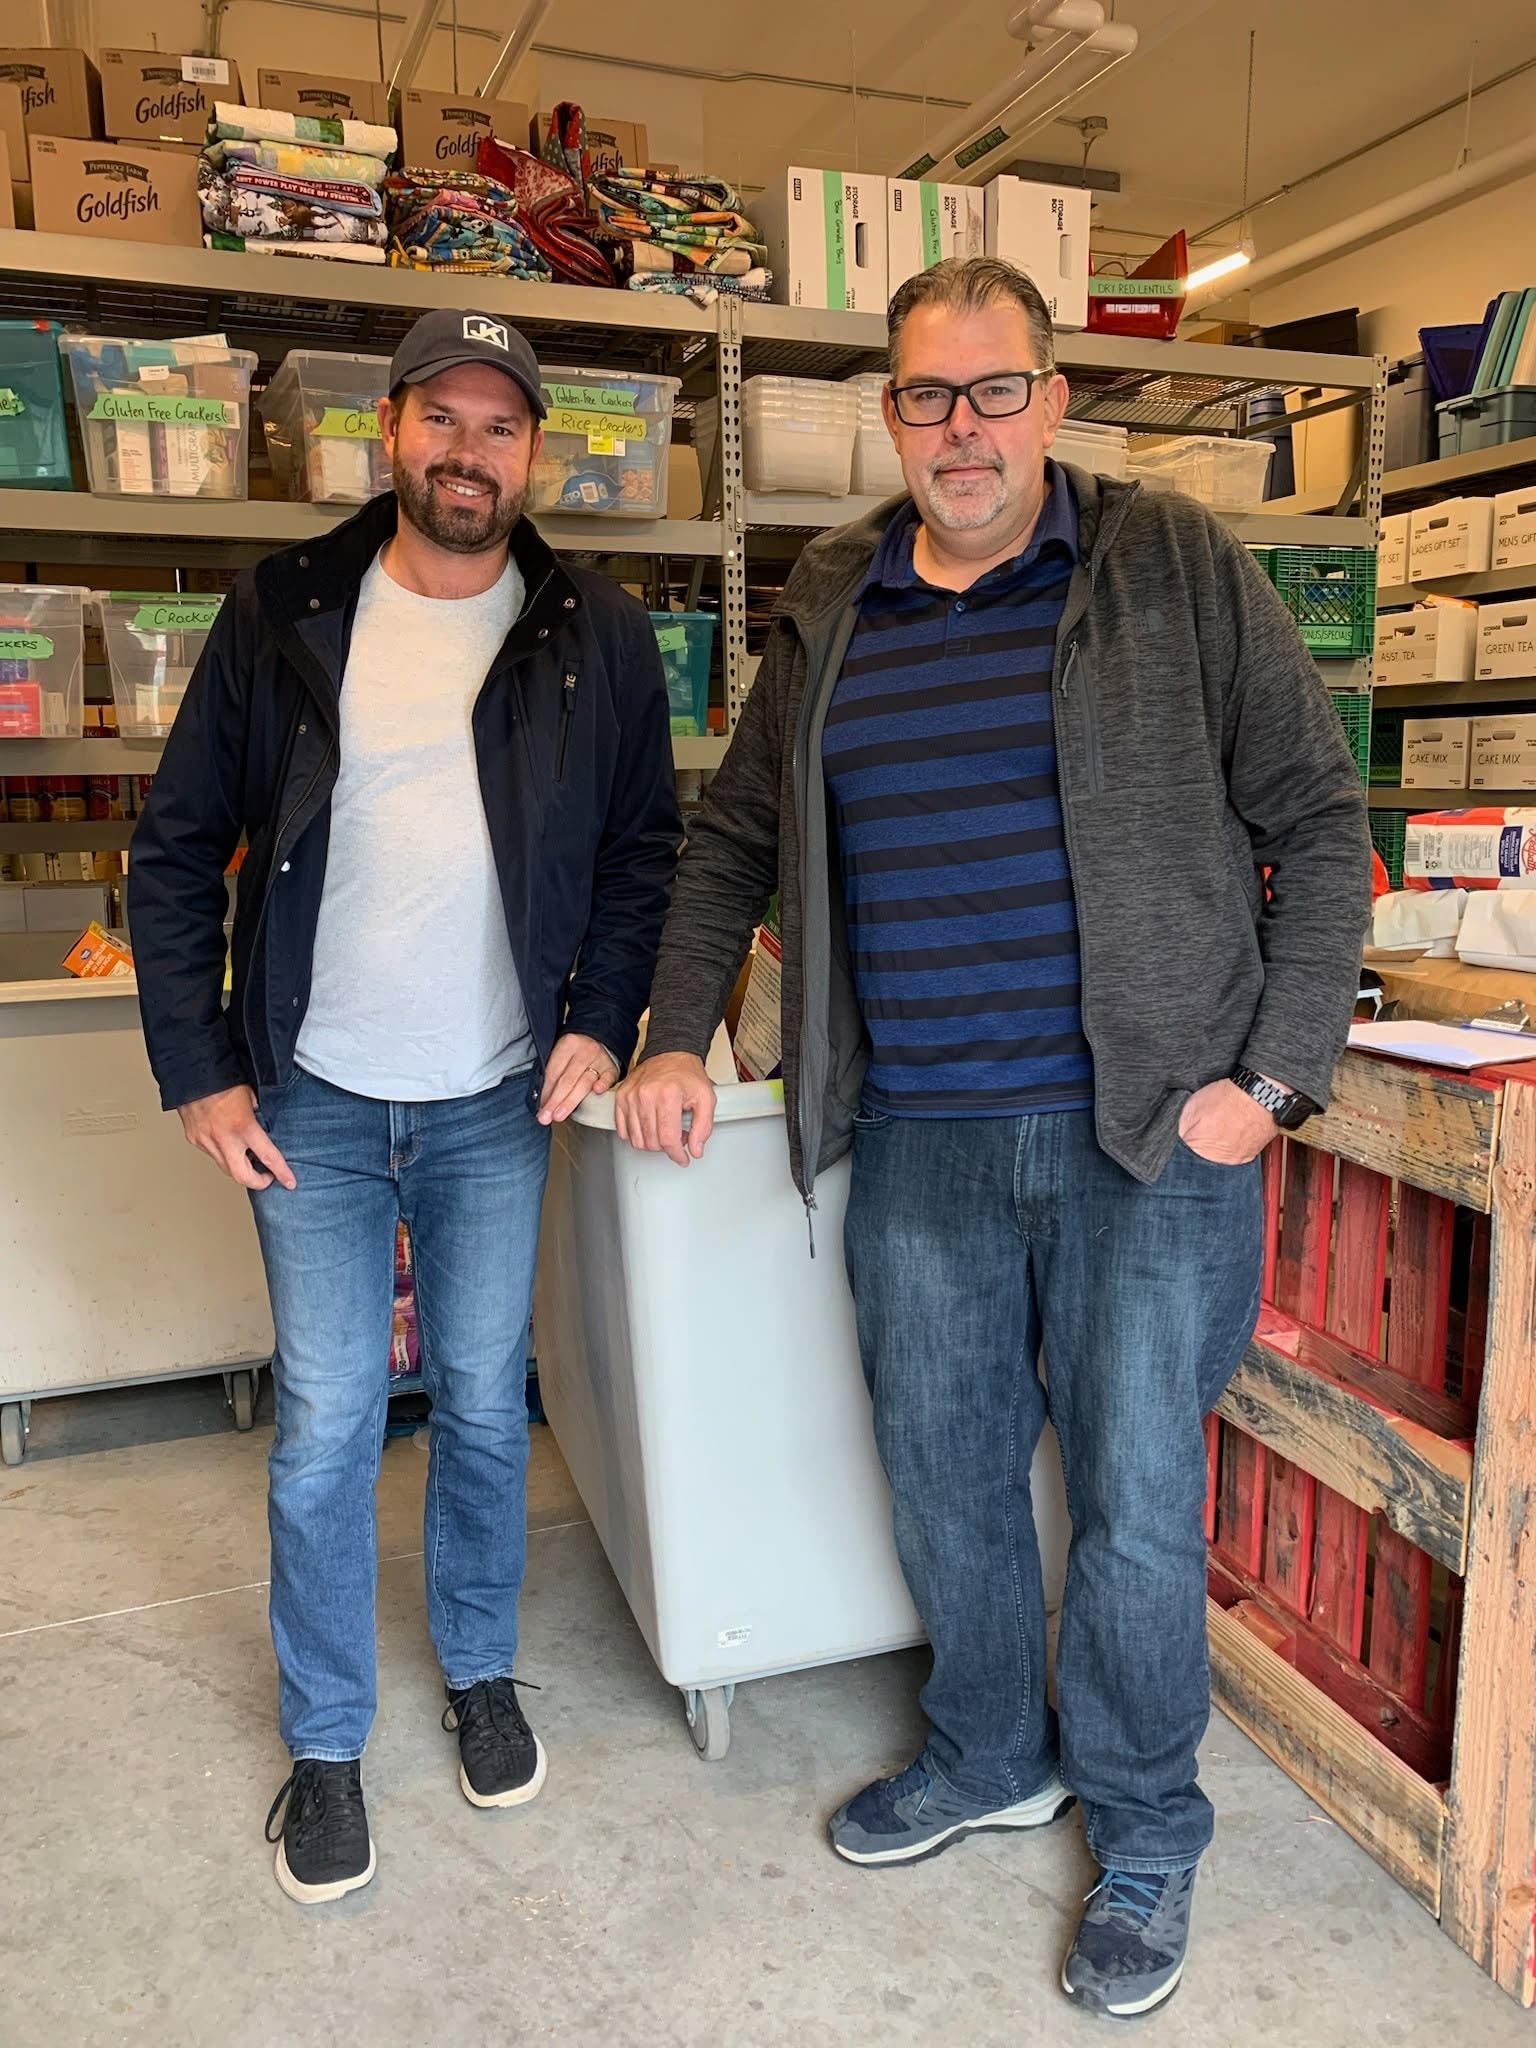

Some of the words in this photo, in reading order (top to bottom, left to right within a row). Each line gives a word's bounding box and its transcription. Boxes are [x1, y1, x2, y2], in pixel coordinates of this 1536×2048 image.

[135, 87, 206, 124] Goldfish
[435, 131, 482, 160] Goldf
[126, 166, 144, 177] FARM
[254, 178, 279, 187] POWER
[280, 182, 298, 191] PLAY
[77, 184, 159, 223] Goldfish
[1097, 283, 1116, 294] DRY
[1118, 283, 1136, 295] RED
[1138, 284, 1174, 295] LENTILS
[469, 322, 502, 346] JK
[103, 398, 145, 418] Gluten
[147, 401, 171, 420] Free
[561, 413, 591, 430] Rice
[599, 416, 643, 438] Crackers
[187, 423, 200, 482] MULTIGRAI
[1411, 543, 1433, 556] LADIES
[1433, 540, 1447, 552] GIFT
[1448, 537, 1462, 549] SET
[1388, 553, 1400, 564] SET
[1402, 650, 1416, 661] TEA
[1485, 642, 1515, 655] GREEN
[1517, 640, 1534, 653] TEA
[1409, 753, 1431, 764] CAKE
[1432, 753, 1448, 764] MIX
[1477, 753, 1500, 765] CAKE
[1502, 753, 1521, 765] MIX
